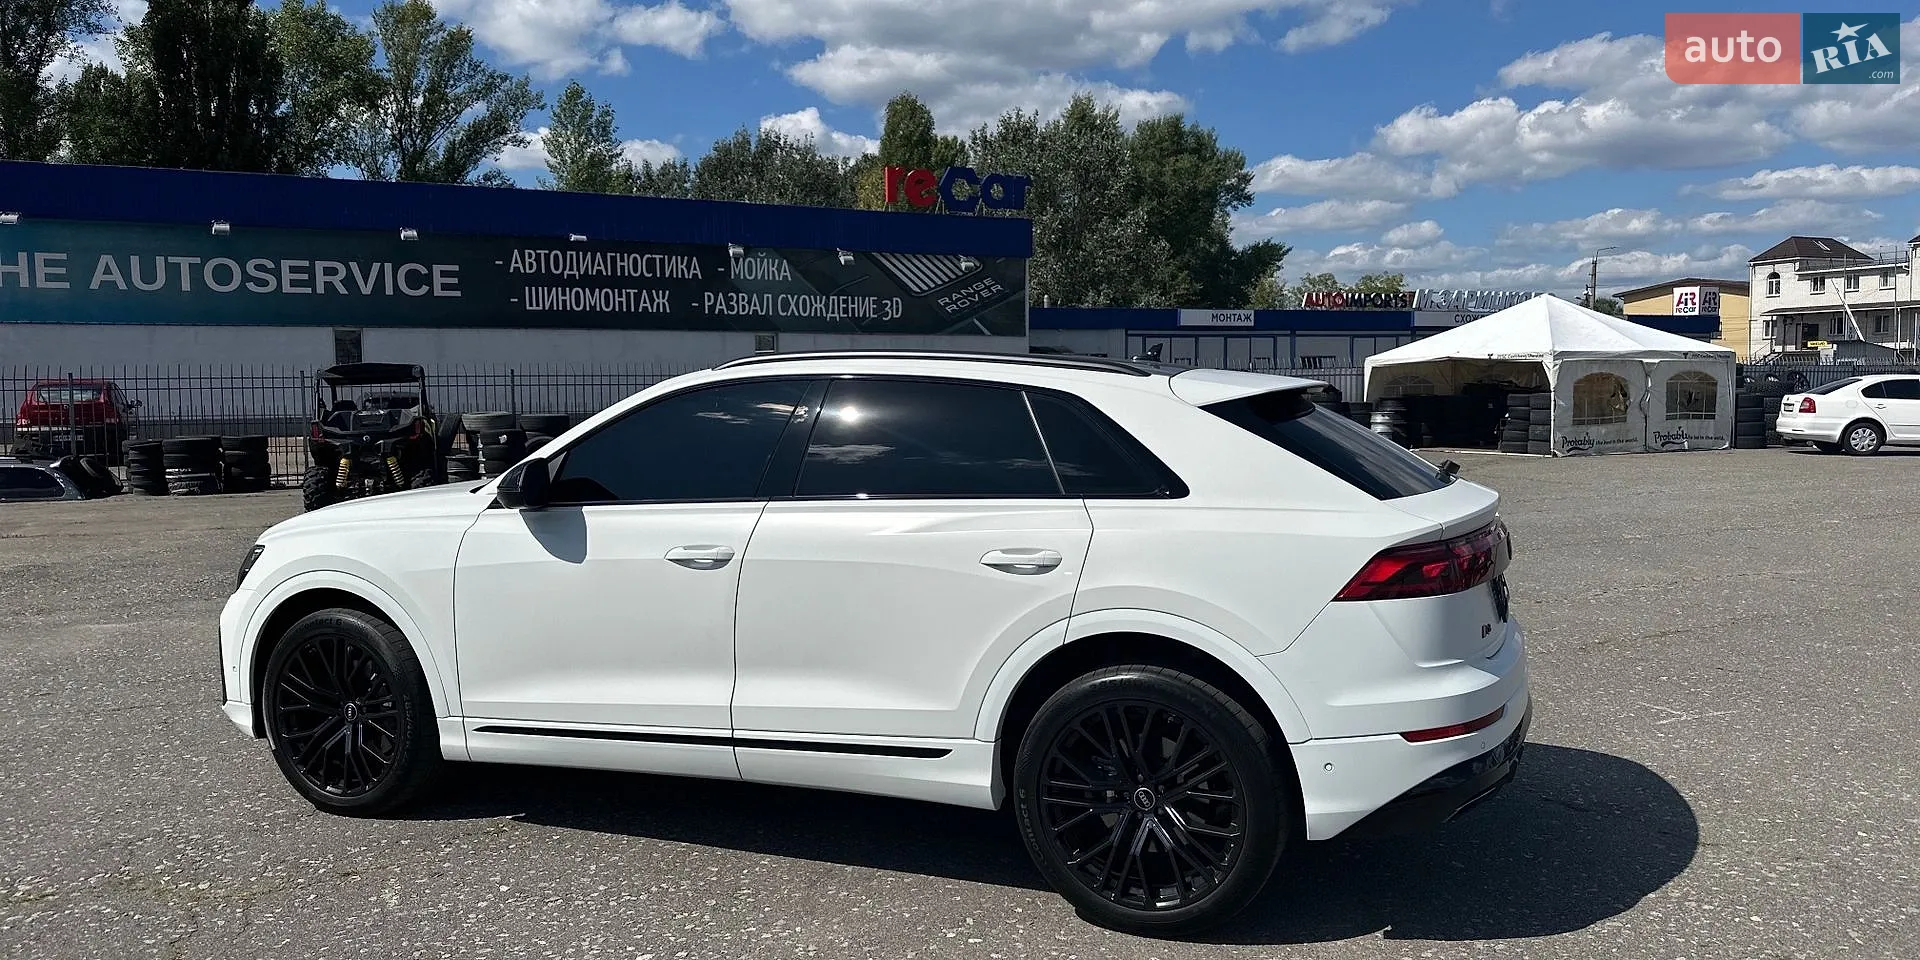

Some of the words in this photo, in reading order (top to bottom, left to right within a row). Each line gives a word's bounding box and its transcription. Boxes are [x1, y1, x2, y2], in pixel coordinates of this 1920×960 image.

[885, 166, 1033, 212] reCar
[89, 255, 462, 297] AUTOSERVICE
[509, 249, 702, 280] АВТОДИАГНОСТИКА
[730, 251, 792, 281] МОЙКА
[525, 286, 671, 313] ШИНОМОНТАЖ
[938, 277, 993, 306] RANGE
[945, 284, 1004, 313] ROVER
[704, 292, 773, 316] РАЗВАЛ
[777, 294, 878, 322] СХОЖДЕНИЕ
[882, 297, 903, 320] 3D
[1211, 313, 1252, 323] МОНТАЖ
[1561, 433, 1595, 452] Probably
